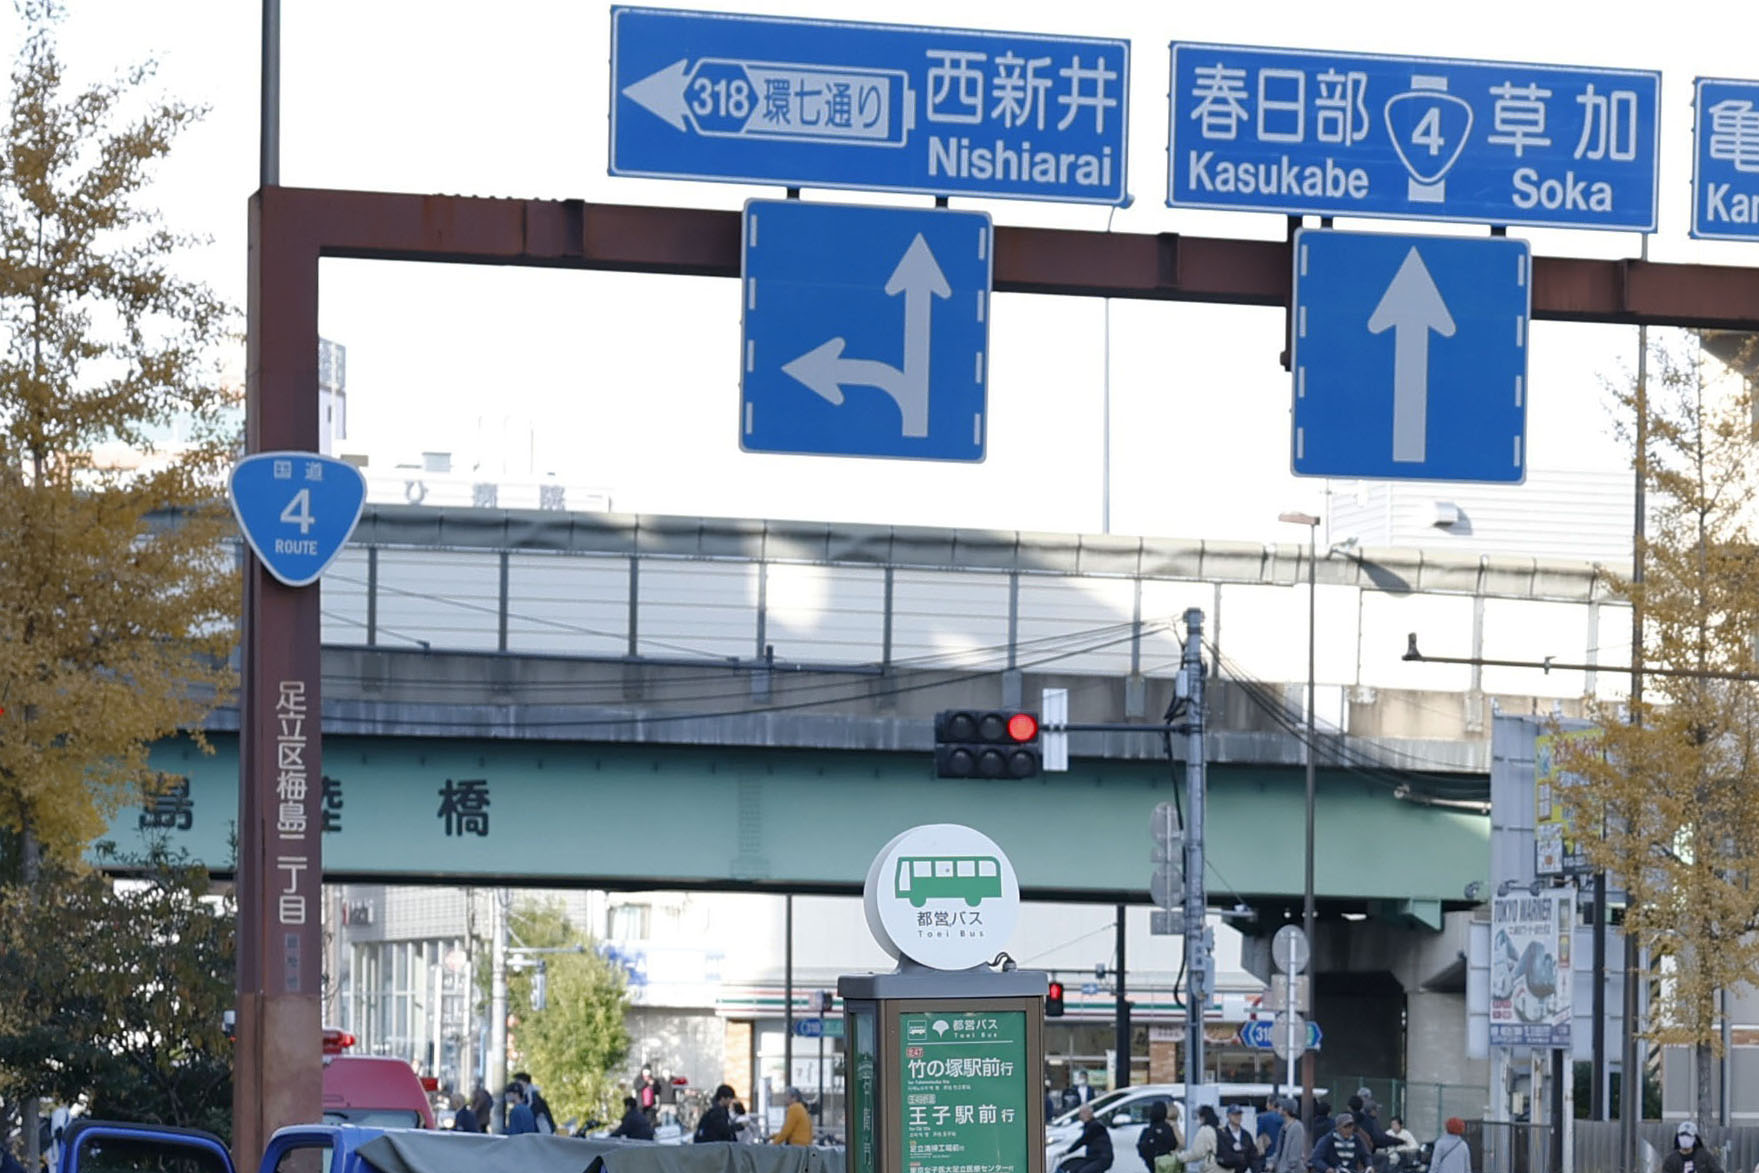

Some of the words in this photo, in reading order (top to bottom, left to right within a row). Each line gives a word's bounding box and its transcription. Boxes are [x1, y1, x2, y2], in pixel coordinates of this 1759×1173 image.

[692, 77, 750, 119] 318
[762, 77, 883, 130] 環七通り
[926, 48, 1118, 134] 西新井
[1190, 62, 1370, 147] 春日部
[1411, 106, 1445, 156] 4
[1487, 81, 1638, 162] 草加
[927, 135, 1112, 187] Nishiarai
[1188, 149, 1370, 199] Kasukabe
[1511, 167, 1613, 212] Soka
[273, 460, 322, 481] 国道
[280, 488, 315, 534] 4
[275, 538, 318, 556] ROUTE
[276, 680, 308, 925] 足立区梅島二丁目
[917, 911, 983, 927] 都営バス
[918, 930, 949, 938] Toei
[952, 1019, 998, 1031] 都営バス
[908, 1058, 1014, 1079] 竹の塚駅前行
[909, 1104, 1016, 1125] 王子駅前行
